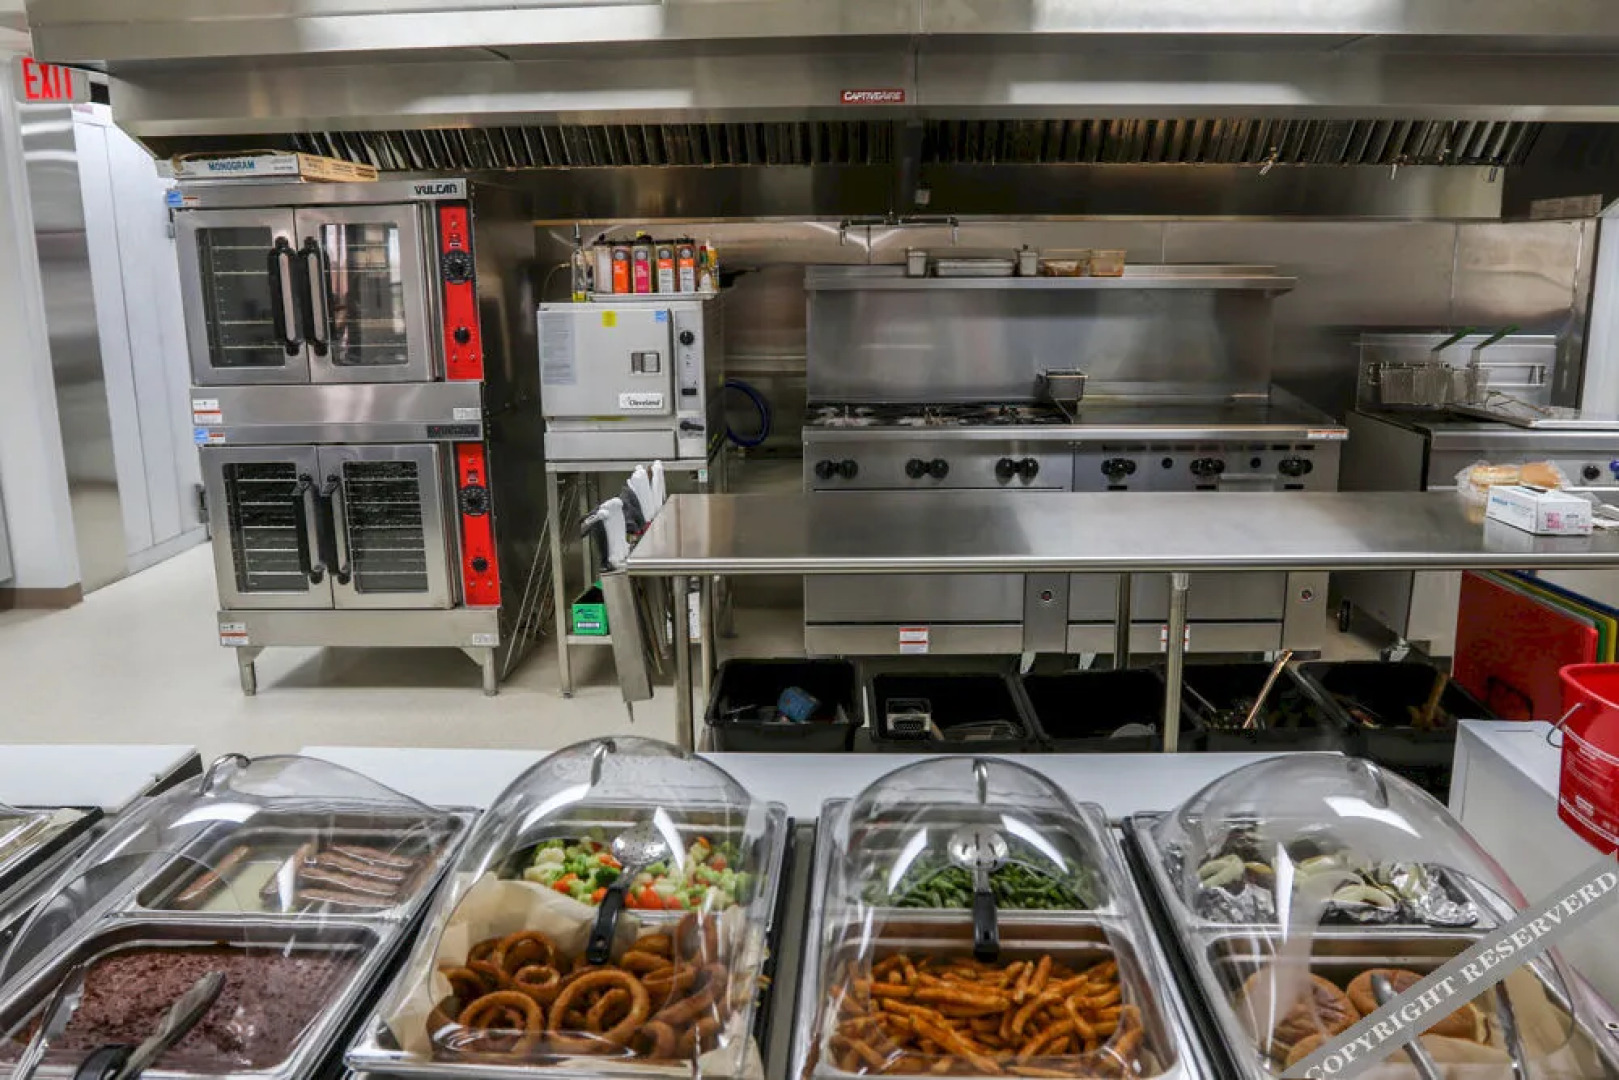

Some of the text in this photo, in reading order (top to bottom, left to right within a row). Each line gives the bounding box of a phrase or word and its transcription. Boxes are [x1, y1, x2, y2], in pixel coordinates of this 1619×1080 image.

[21, 57, 74, 100] EXIT
[208, 160, 256, 171] MONOGRAM
[414, 183, 458, 195] VULCAN
